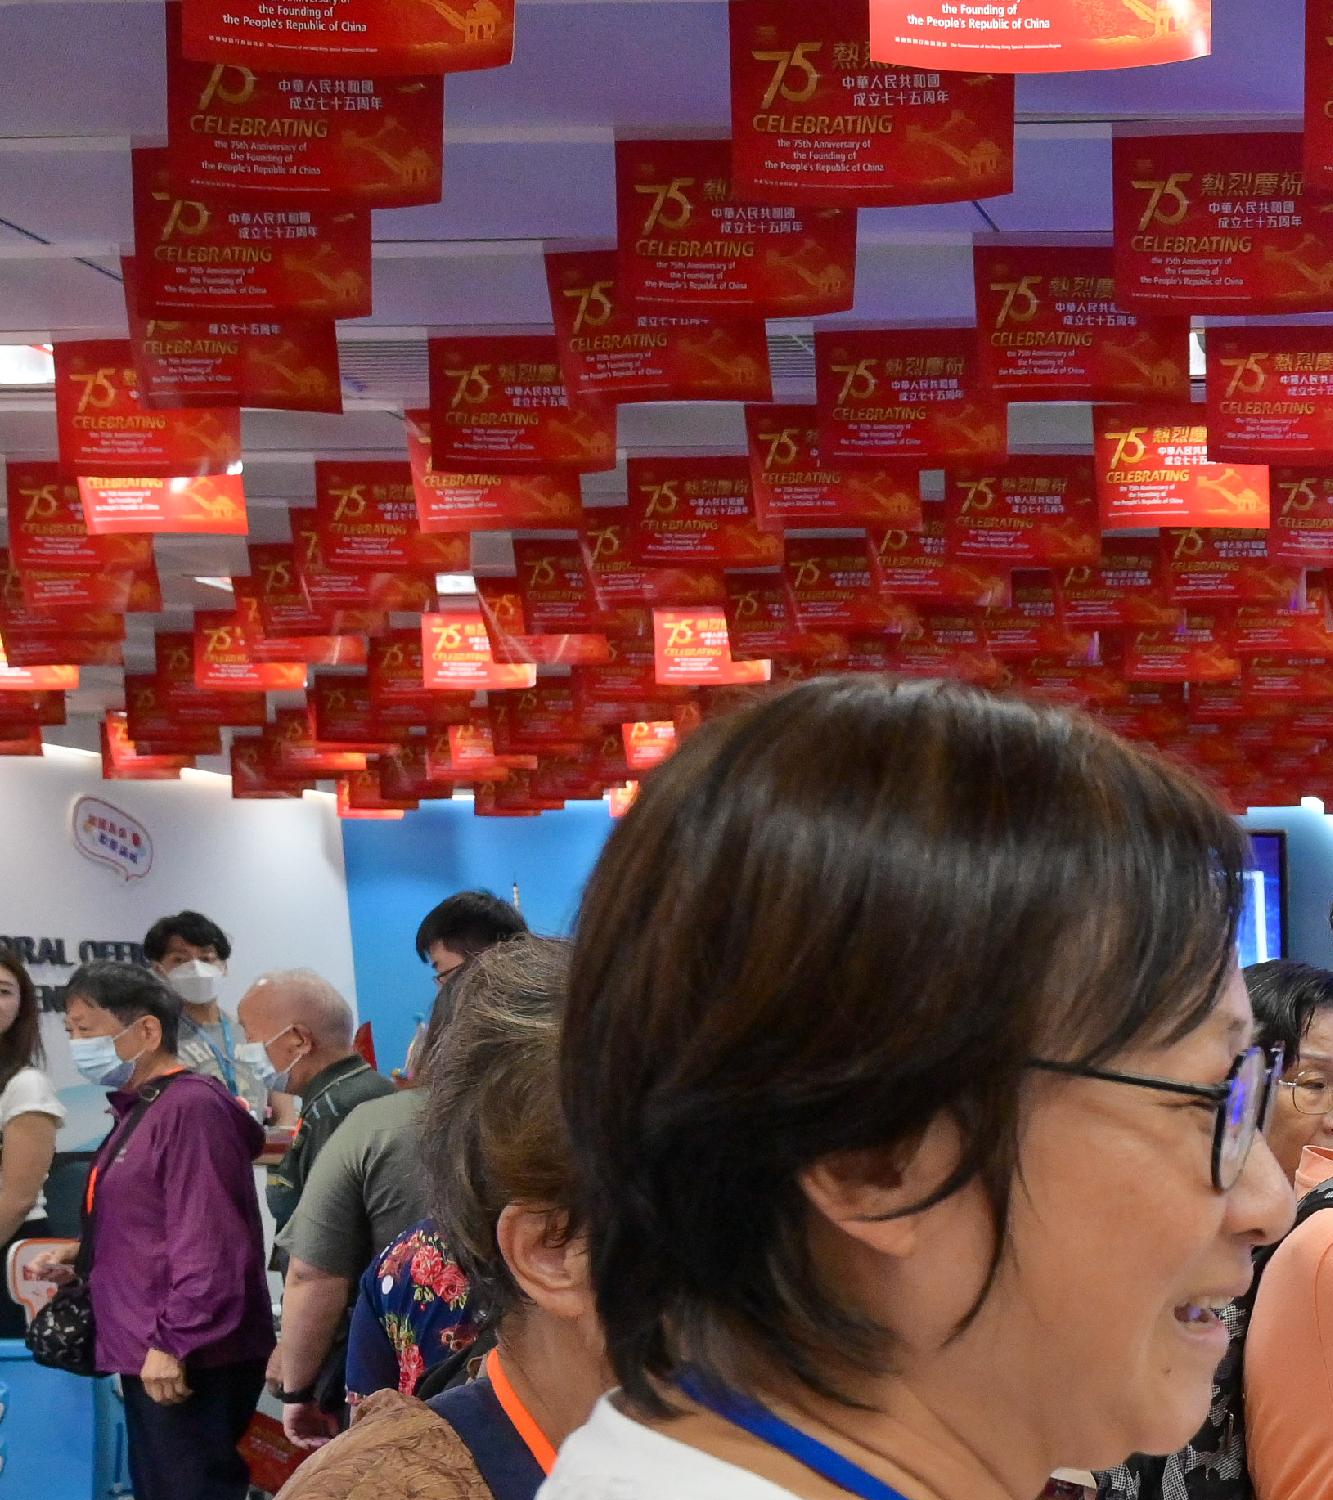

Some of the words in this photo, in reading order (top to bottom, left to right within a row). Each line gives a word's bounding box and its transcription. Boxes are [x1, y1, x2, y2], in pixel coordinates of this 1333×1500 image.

[258, 3, 274, 14] the
[276, 4, 321, 18] Founding
[325, 6, 334, 16] of
[942, 3, 957, 14] the
[960, 4, 1004, 16] Founding
[1008, 3, 1017, 14] of
[223, 14, 239, 25] the
[242, 16, 283, 30] People's
[286, 19, 326, 32] Republic
[328, 21, 338, 31] of
[340, 23, 367, 32] China
[908, 15, 923, 25] the
[926, 16, 966, 29] People's
[969, 18, 1009, 30] Republic
[1012, 18, 1021, 28] of
[1024, 19, 1050, 29] China
[750, 42, 828, 109] 75
[842, 74, 940, 90] 中華人民共和國
[278, 78, 374, 95] 中華人民共和國
[289, 96, 383, 111] 成立七十五周年
[853, 91, 950, 106] 成立七十五周年
[190, 115, 329, 138] CELEBRATING
[752, 115, 893, 133] CELEBRATING
[777, 139, 791, 147] the
[794, 140, 811, 148] 75th
[813, 140, 860, 149] Anniversary
[862, 140, 870, 148] of
[794, 151, 807, 160] the
[808, 151, 845, 161] Founding
[848, 151, 856, 159] of
[766, 161, 779, 169] the
[781, 162, 814, 172] People's
[816, 163, 849, 172] Republic
[851, 163, 859, 171] of
[861, 163, 884, 171] China
[1200, 172, 1305, 197] 熱烈慶祝
[633, 177, 699, 235] 75
[1130, 173, 1195, 231] 75
[1209, 201, 1295, 214] 中華人民共和國
[721, 221, 803, 233] 成立七十五周年
[1218, 215, 1303, 229] 成立七十五周年
[635, 240, 755, 257] CELEBRATING
[1130, 236, 1252, 252] CELEBRATING
[154, 246, 273, 262] CELEBRATING
[989, 277, 1044, 327] 75
[566, 332, 667, 352] CELEBRATING
[989, 330, 1093, 347] CELEBRATING
[829, 359, 882, 404] 75
[1219, 353, 1270, 398] 75
[443, 364, 496, 408] 75
[832, 407, 926, 420] CELEBRATING
[1219, 401, 1315, 414] CELEBRATING
[445, 412, 539, 425] CELEBRATING
[1104, 427, 1149, 468] 75
[1105, 471, 1189, 482] CELEBRATING
